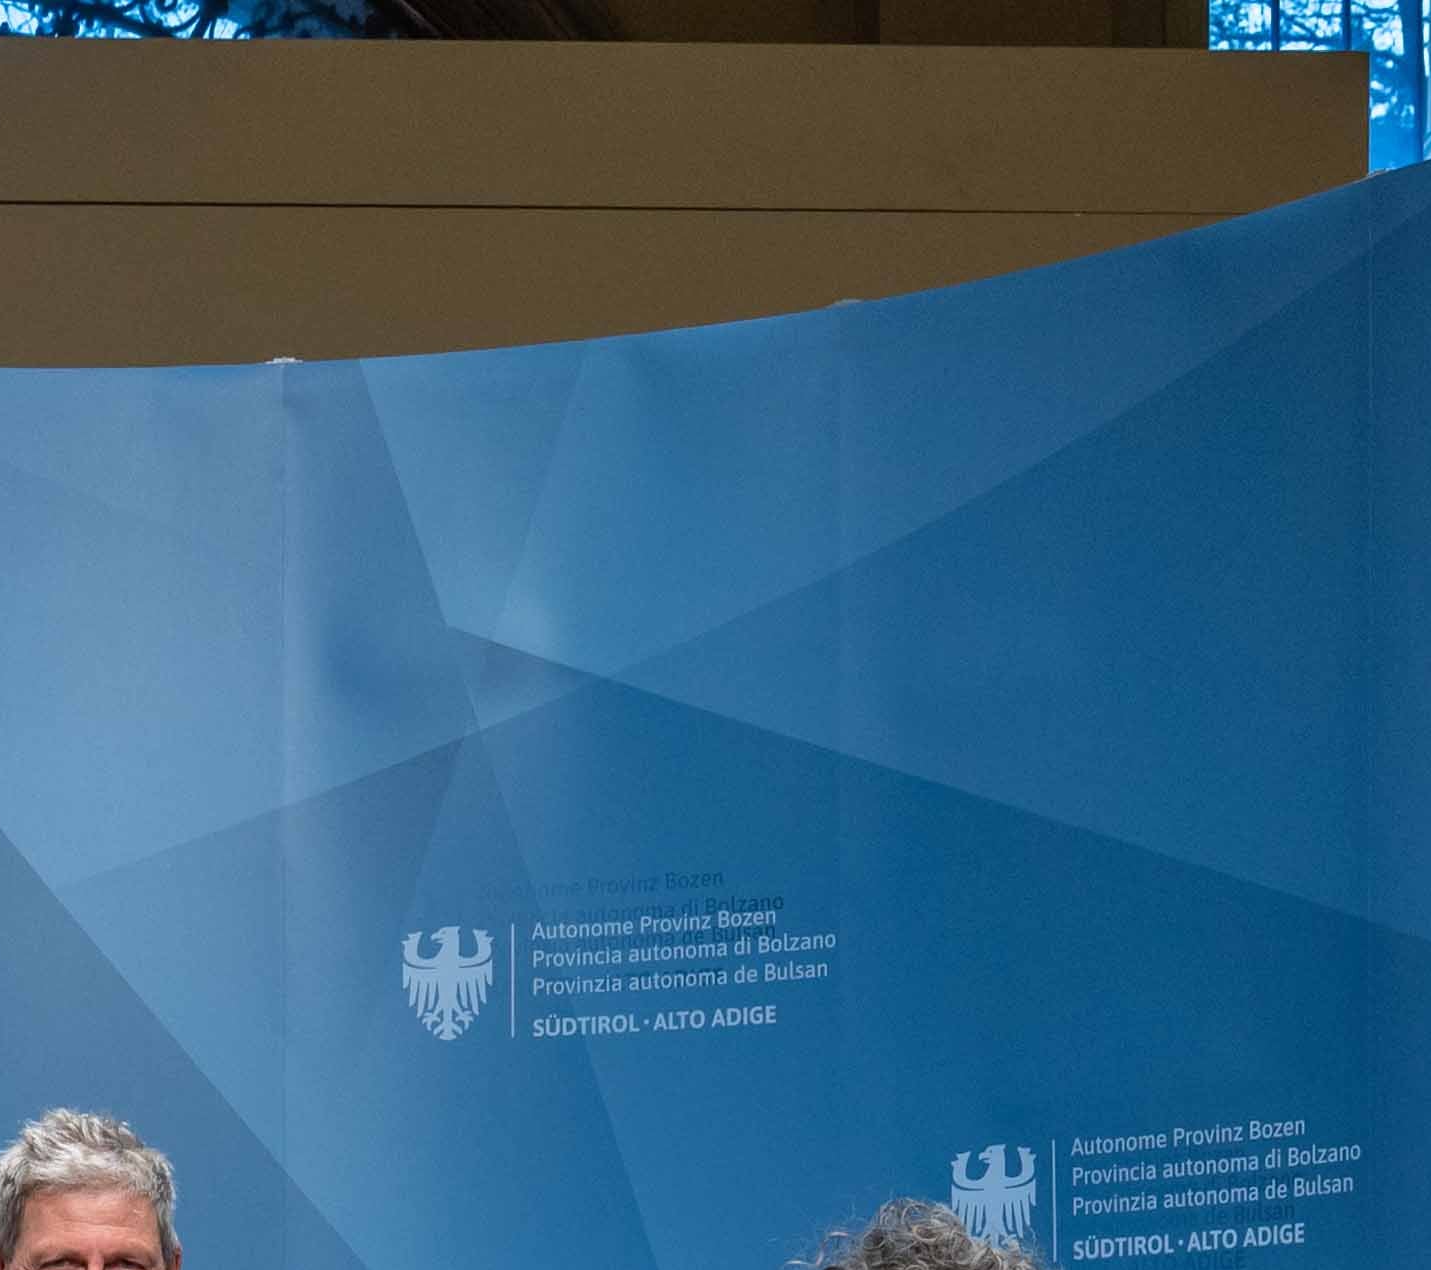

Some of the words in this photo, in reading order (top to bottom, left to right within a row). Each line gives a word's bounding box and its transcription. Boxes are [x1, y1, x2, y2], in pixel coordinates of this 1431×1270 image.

[532, 921, 633, 939] Autonome
[641, 913, 711, 933] Provinz
[718, 911, 775, 928] Bozen
[533, 947, 621, 967] Provincia
[629, 943, 727, 962] autonoma
[734, 936, 750, 955] di
[759, 933, 836, 954] Bolzano
[533, 975, 621, 996] Provinzia
[629, 971, 727, 991] autonoma
[735, 965, 757, 983] de
[765, 960, 827, 982] Bulsan
[533, 1014, 640, 1036] SÜDTIROL
[654, 1010, 705, 1031] ALTO
[712, 1005, 776, 1027] ADIGE
[1071, 1134, 1166, 1156] Autonome
[1174, 1124, 1243, 1147] Provinz
[1250, 1120, 1304, 1140] Bozen
[1073, 1161, 1156, 1186] Provincia
[1163, 1156, 1258, 1178] autonoma
[1265, 1149, 1280, 1168] di
[1288, 1144, 1360, 1166] Bolzano
[1073, 1192, 1156, 1215] Provinzia
[1164, 1186, 1258, 1209] autonoma
[1265, 1180, 1287, 1199] de
[1294, 1174, 1353, 1197] Bulsan
[1074, 1234, 1174, 1260] SÜDTIROL
[1187, 1229, 1237, 1252] ALTO
[1243, 1222, 1304, 1247] ADIGE
